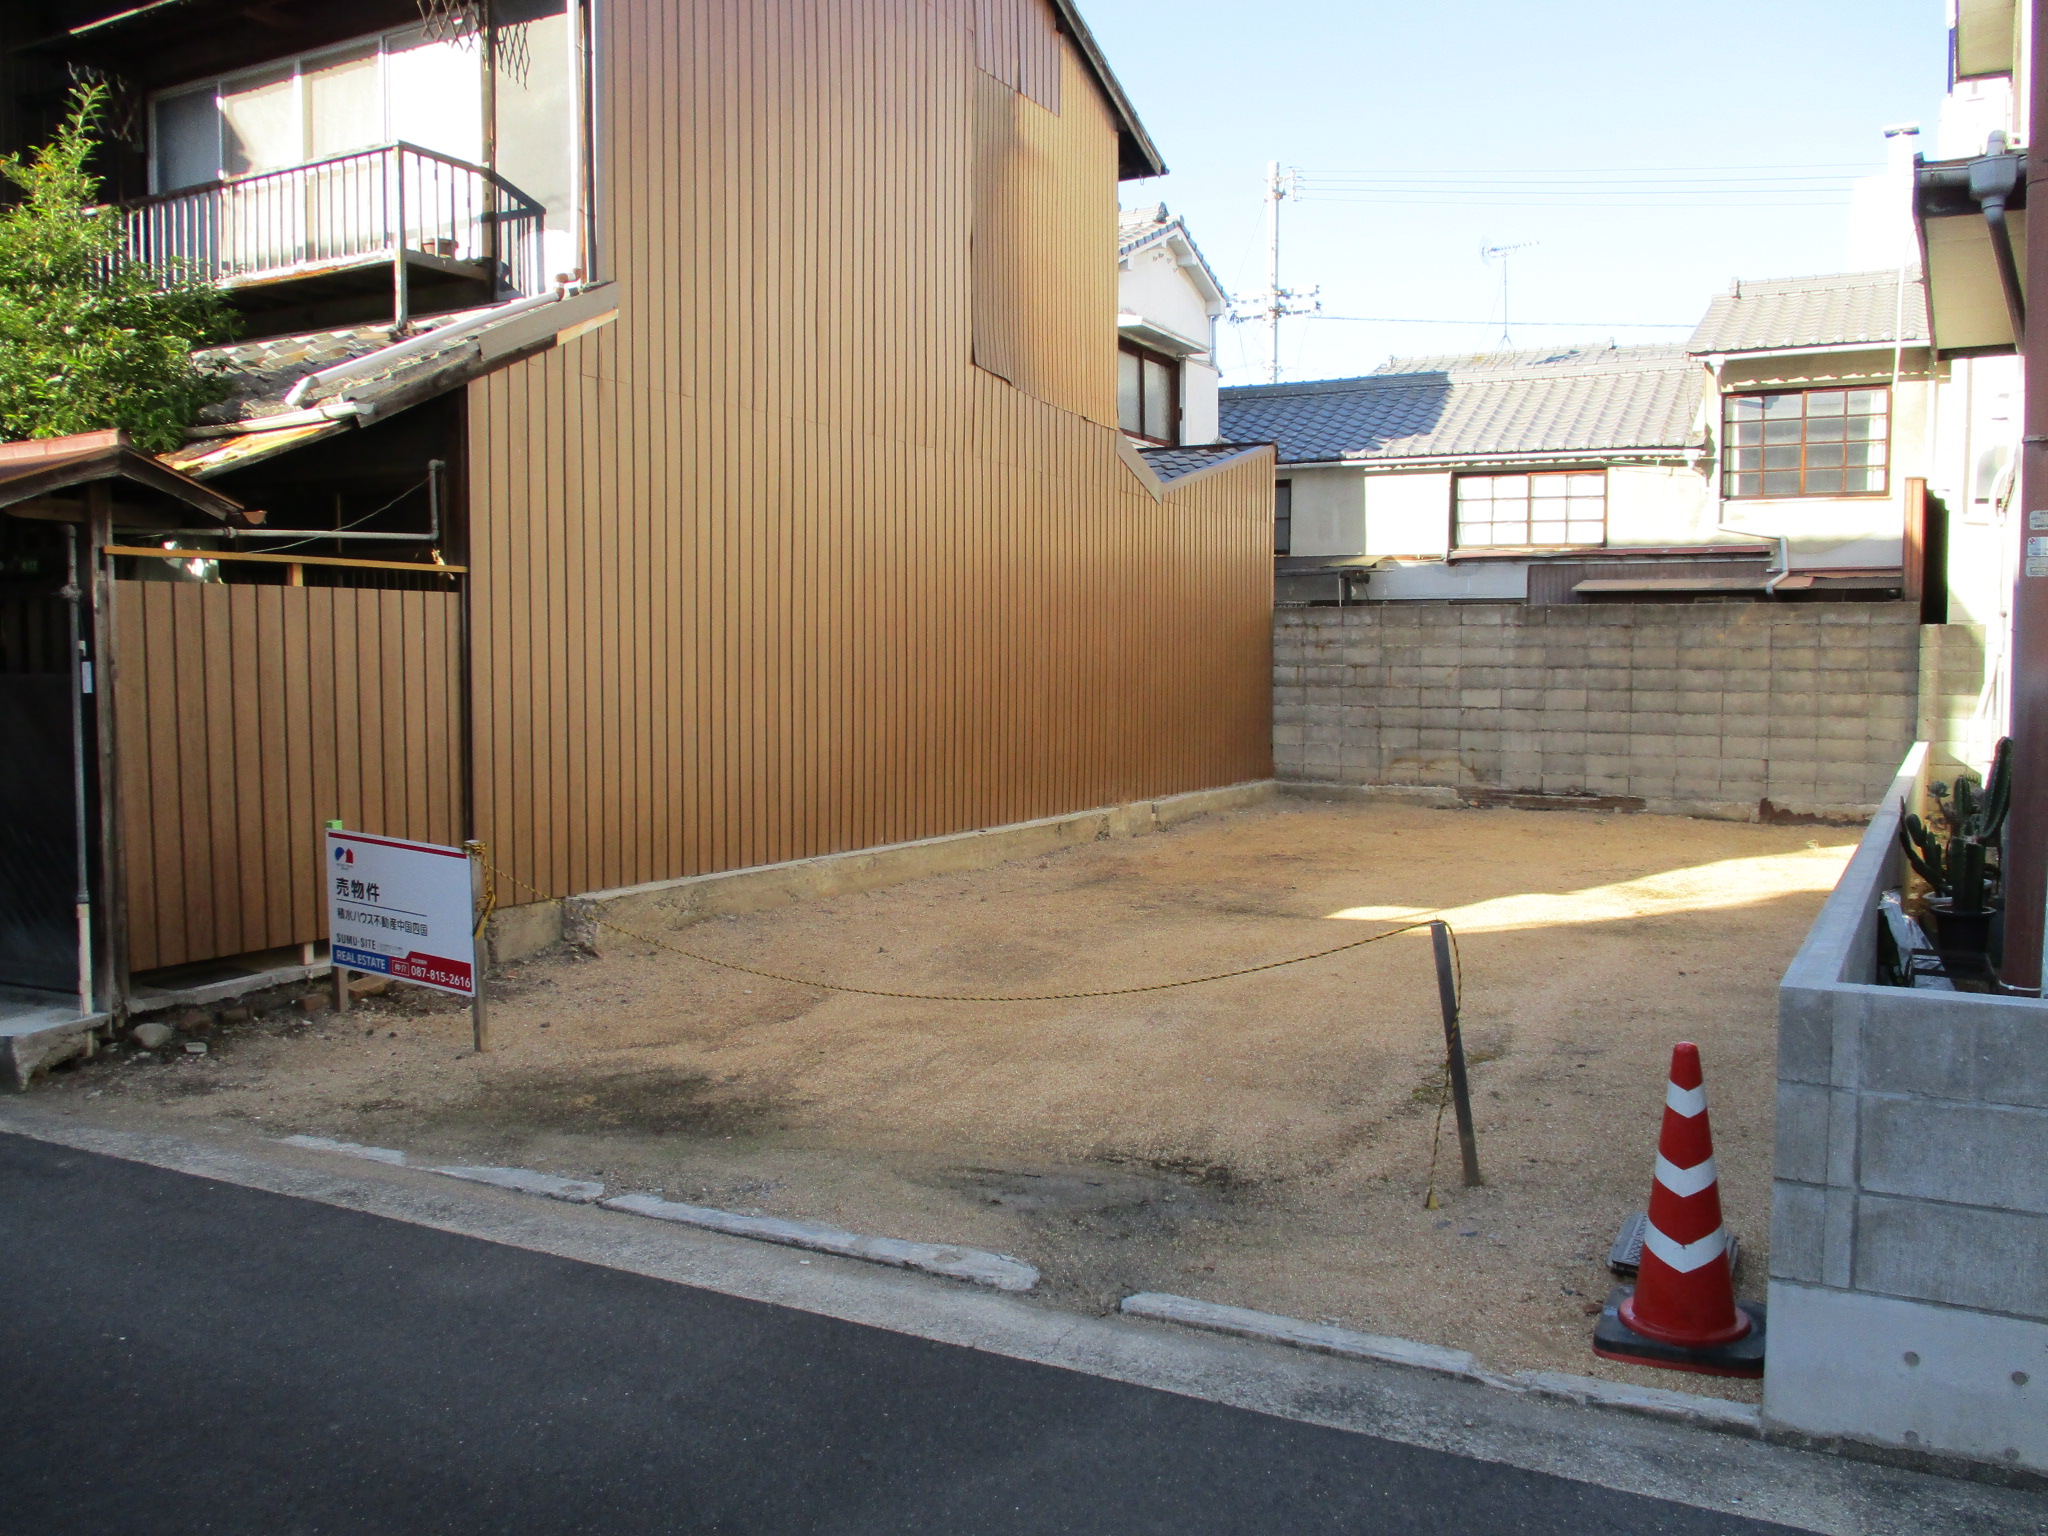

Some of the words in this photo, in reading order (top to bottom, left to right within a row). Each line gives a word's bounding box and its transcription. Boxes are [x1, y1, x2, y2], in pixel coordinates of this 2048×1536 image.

[336, 877, 380, 903] 売物件
[337, 907, 428, 936] 積水ハウス不動産中国四国
[336, 933, 376, 950] SUMU-SITE
[336, 949, 356, 964] REAL
[357, 954, 386, 970] ESTATE
[410, 965, 471, 988] 087-815-2616
